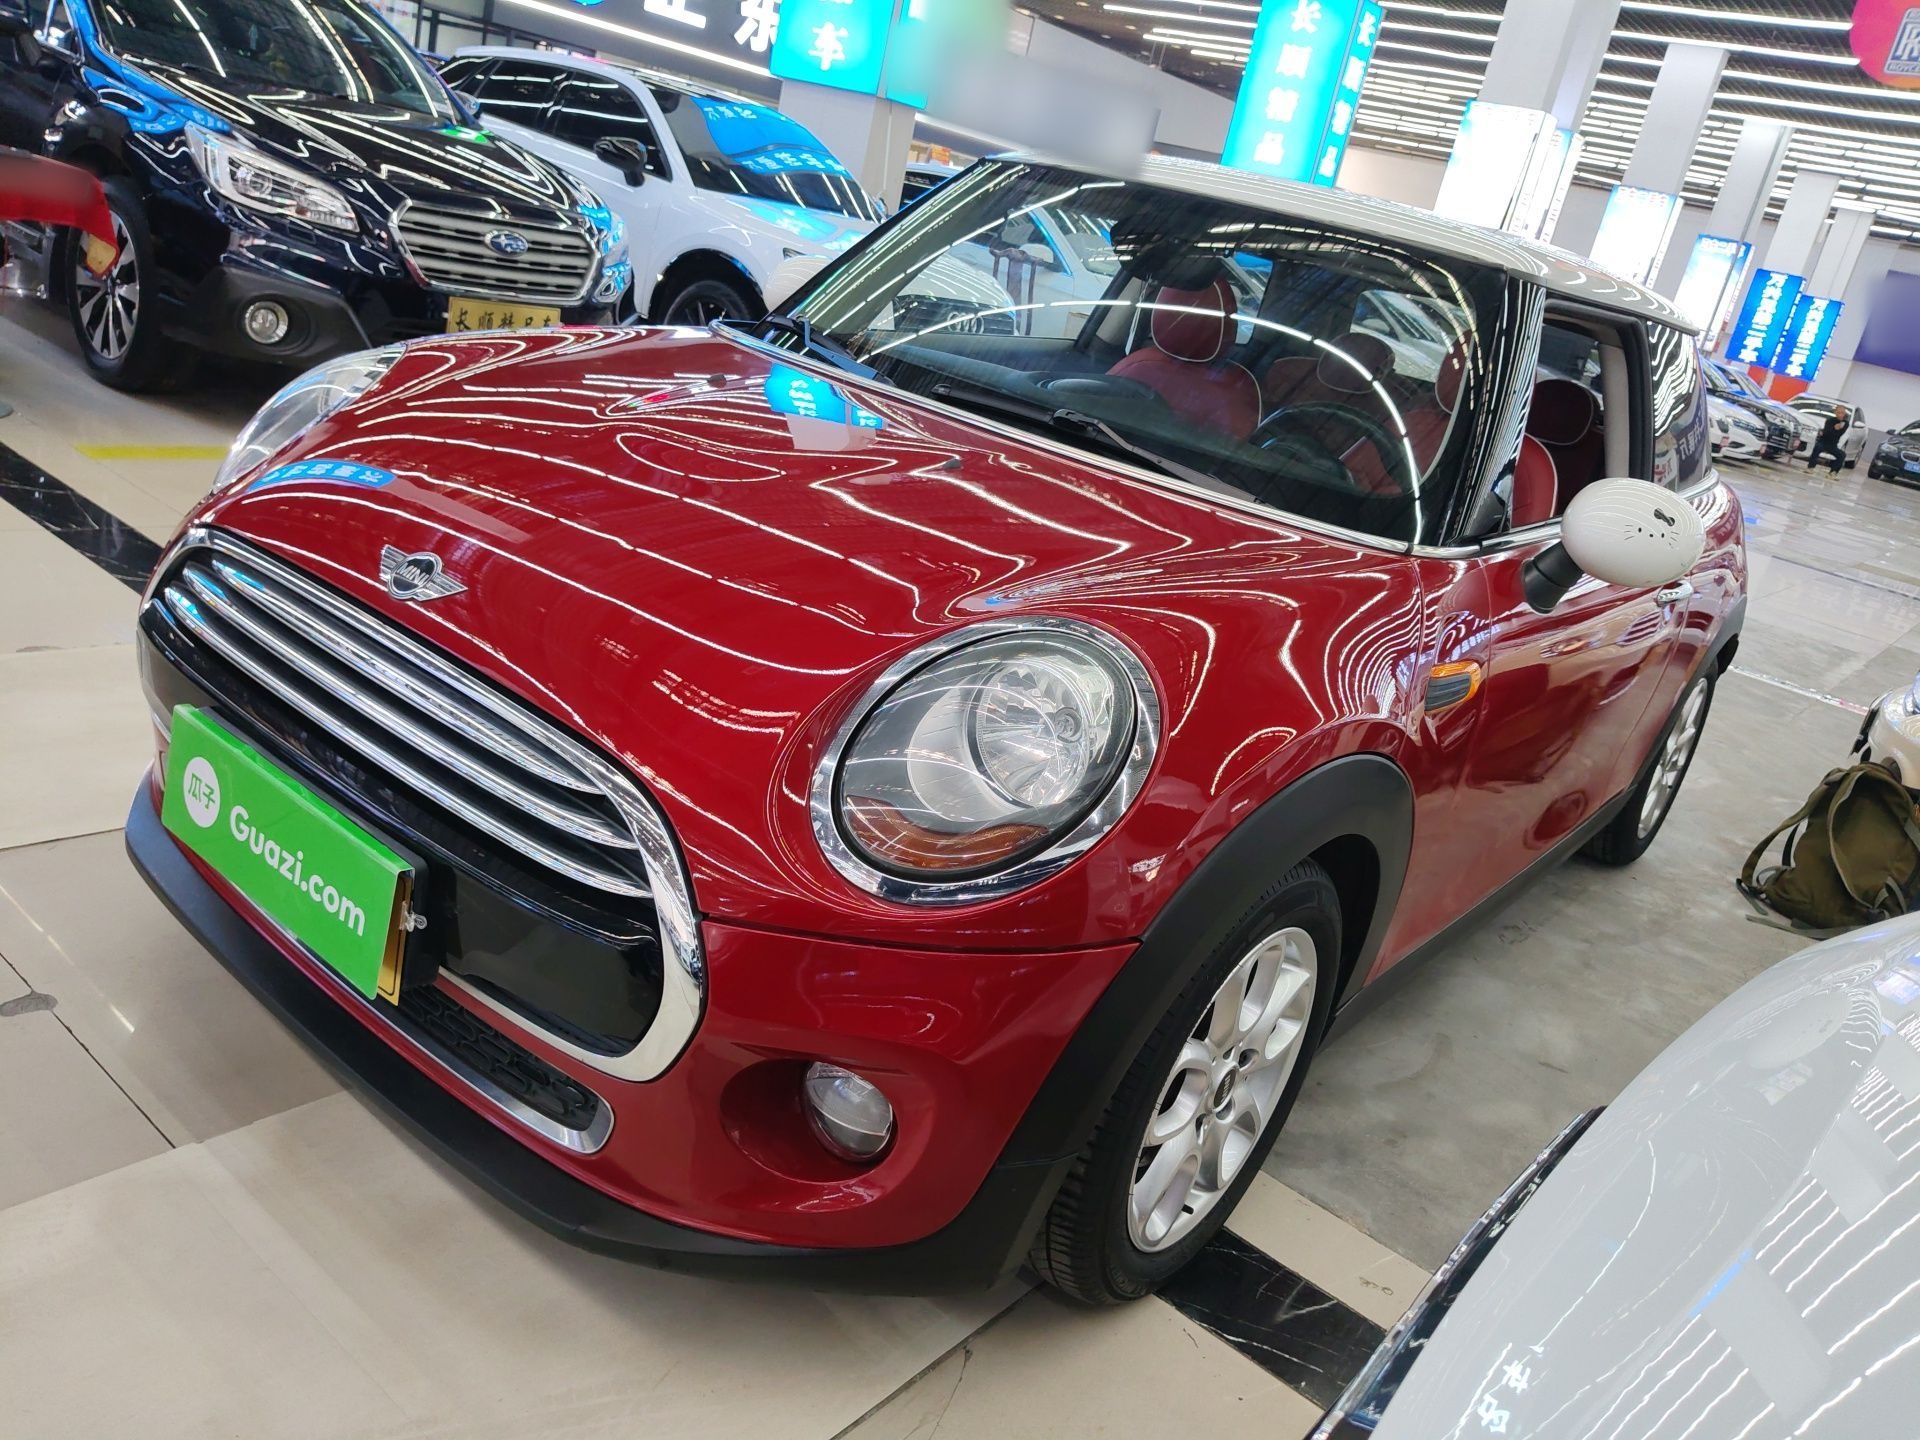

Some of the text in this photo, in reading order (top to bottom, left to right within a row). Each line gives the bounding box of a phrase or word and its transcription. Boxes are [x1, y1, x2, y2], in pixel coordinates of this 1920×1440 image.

[396, 562, 430, 586] MINI
[187, 772, 216, 810] 瓜子
[229, 804, 366, 937] Guazi.com
